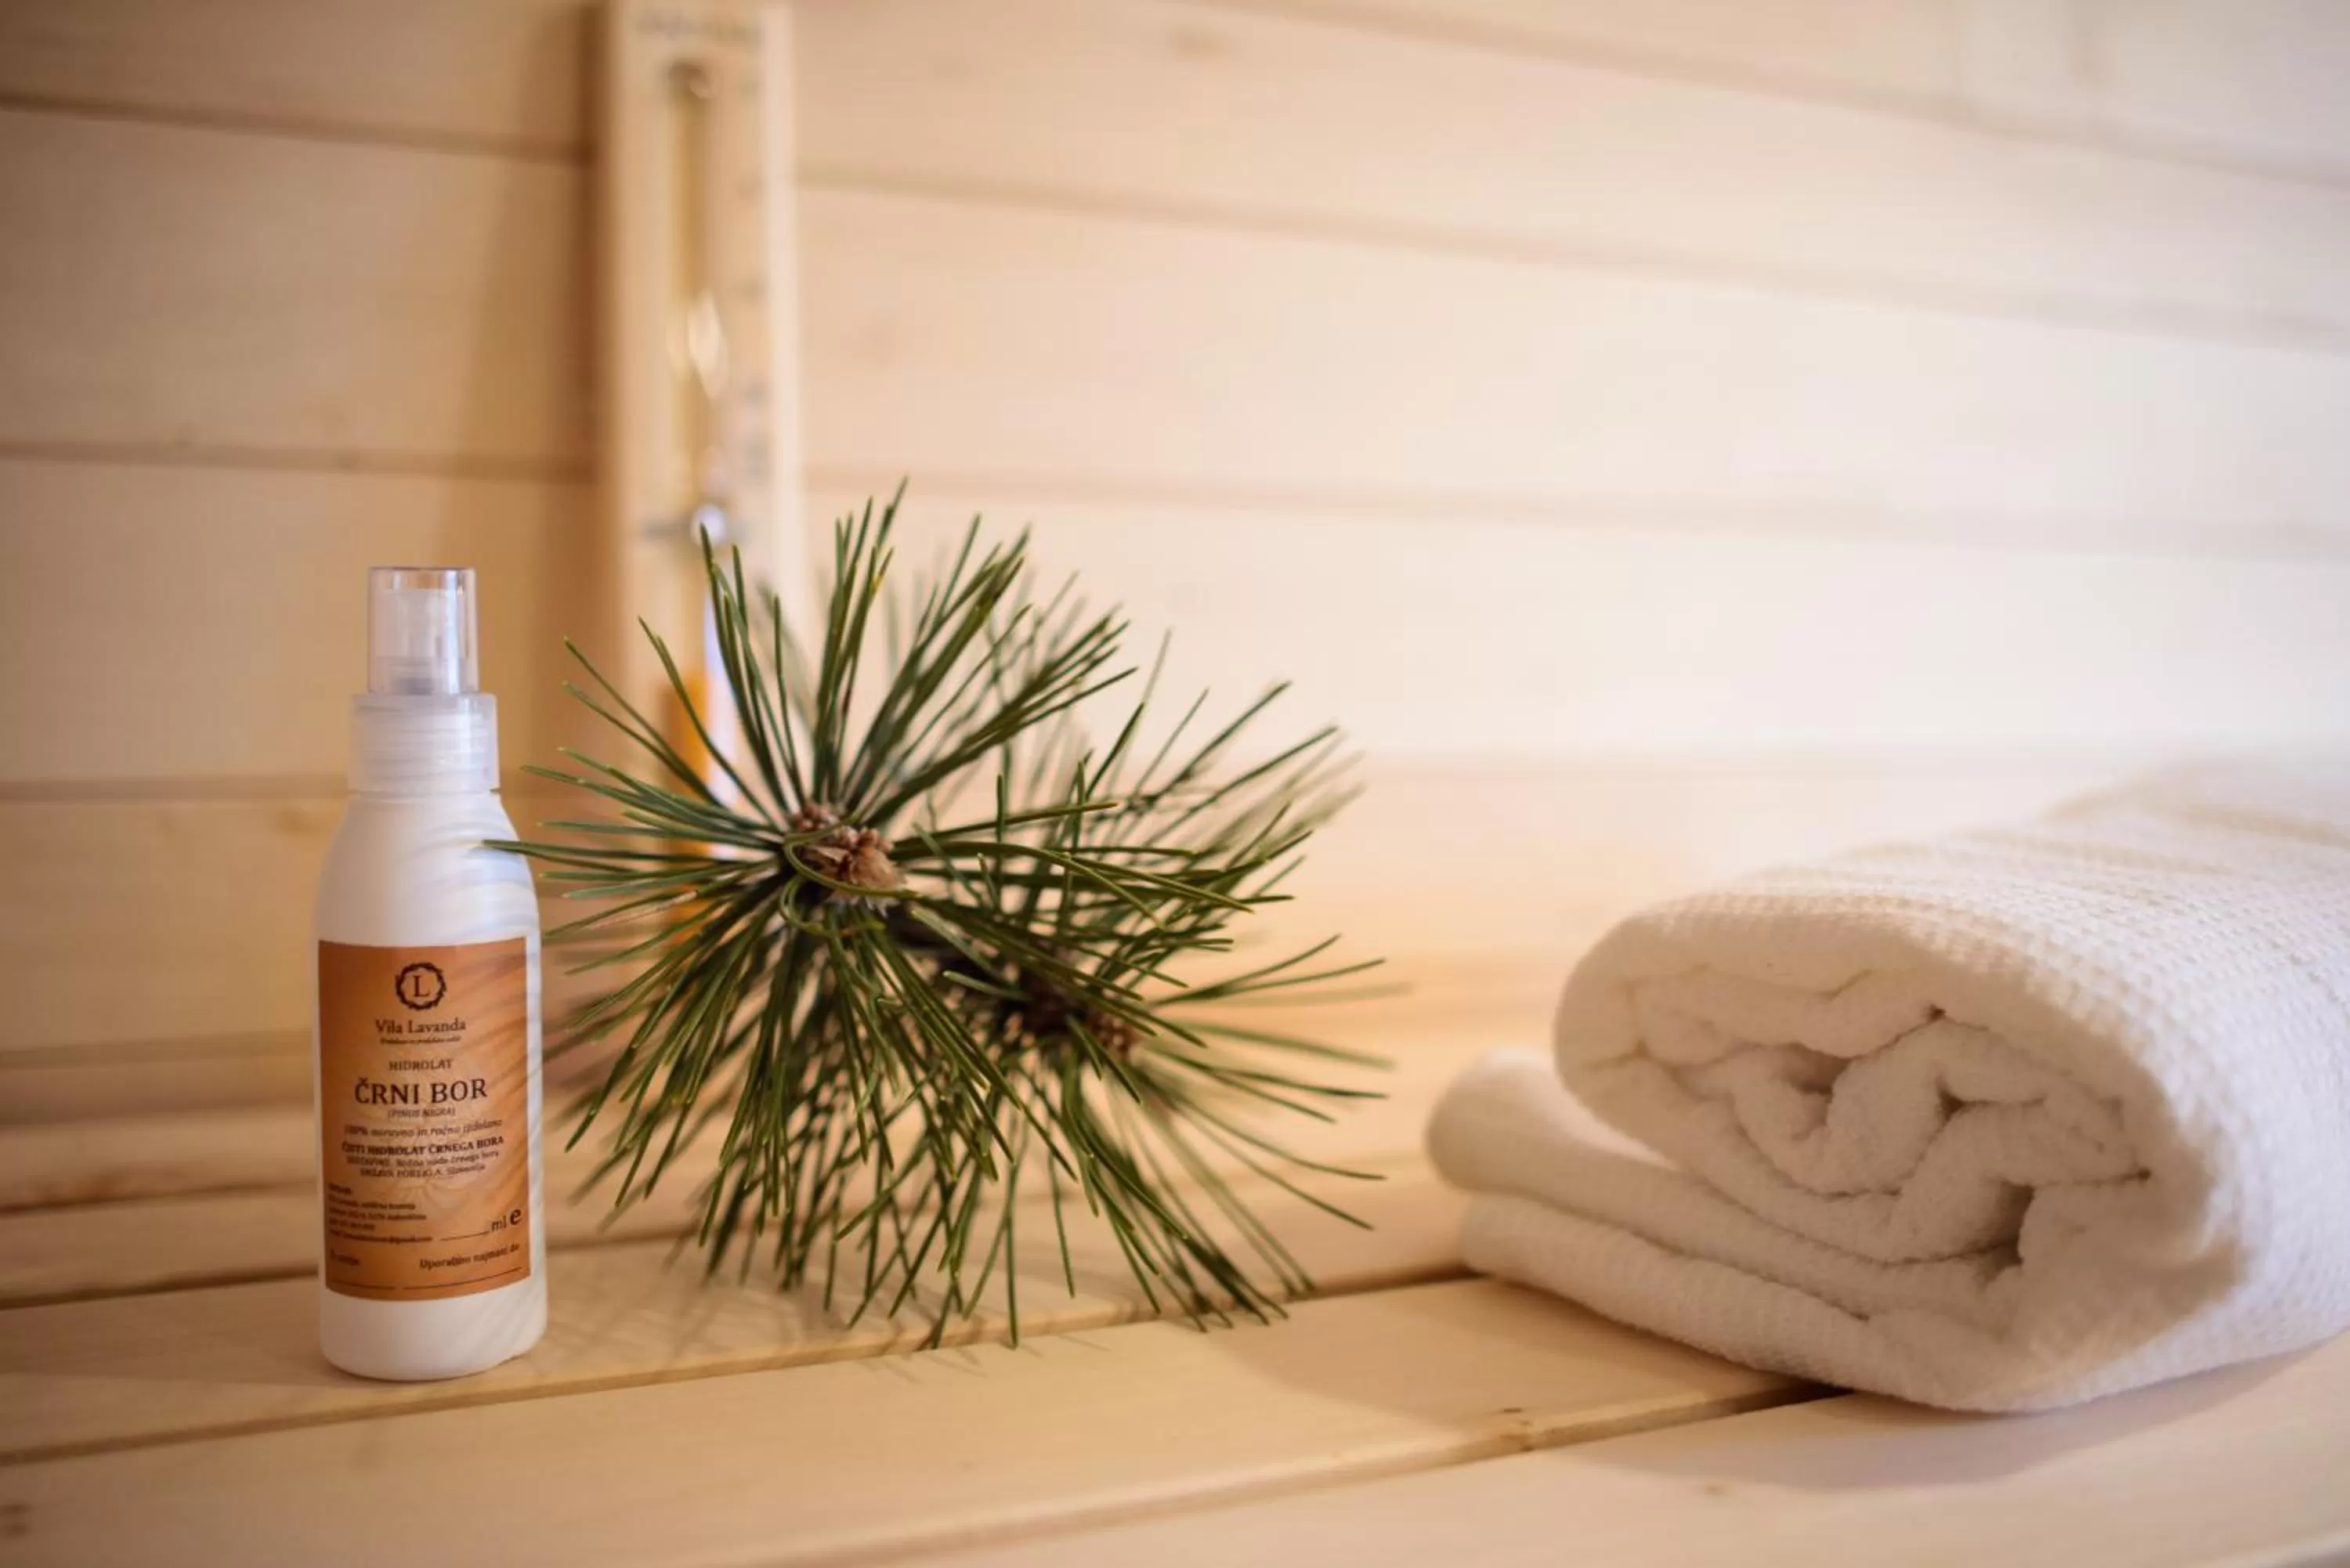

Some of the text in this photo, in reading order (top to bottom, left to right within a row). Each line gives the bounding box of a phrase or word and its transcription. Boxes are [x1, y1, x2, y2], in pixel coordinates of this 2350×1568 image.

[413, 975, 429, 998] L
[375, 1017, 466, 1034] Vila Lavanda
[389, 1059, 452, 1071] HIDROLAT
[355, 1077, 488, 1105] ČRNI BOR
[428, 1141, 474, 1154] ČRNEGA
[476, 1136, 504, 1150] BORA
[491, 1215, 507, 1232] ml
